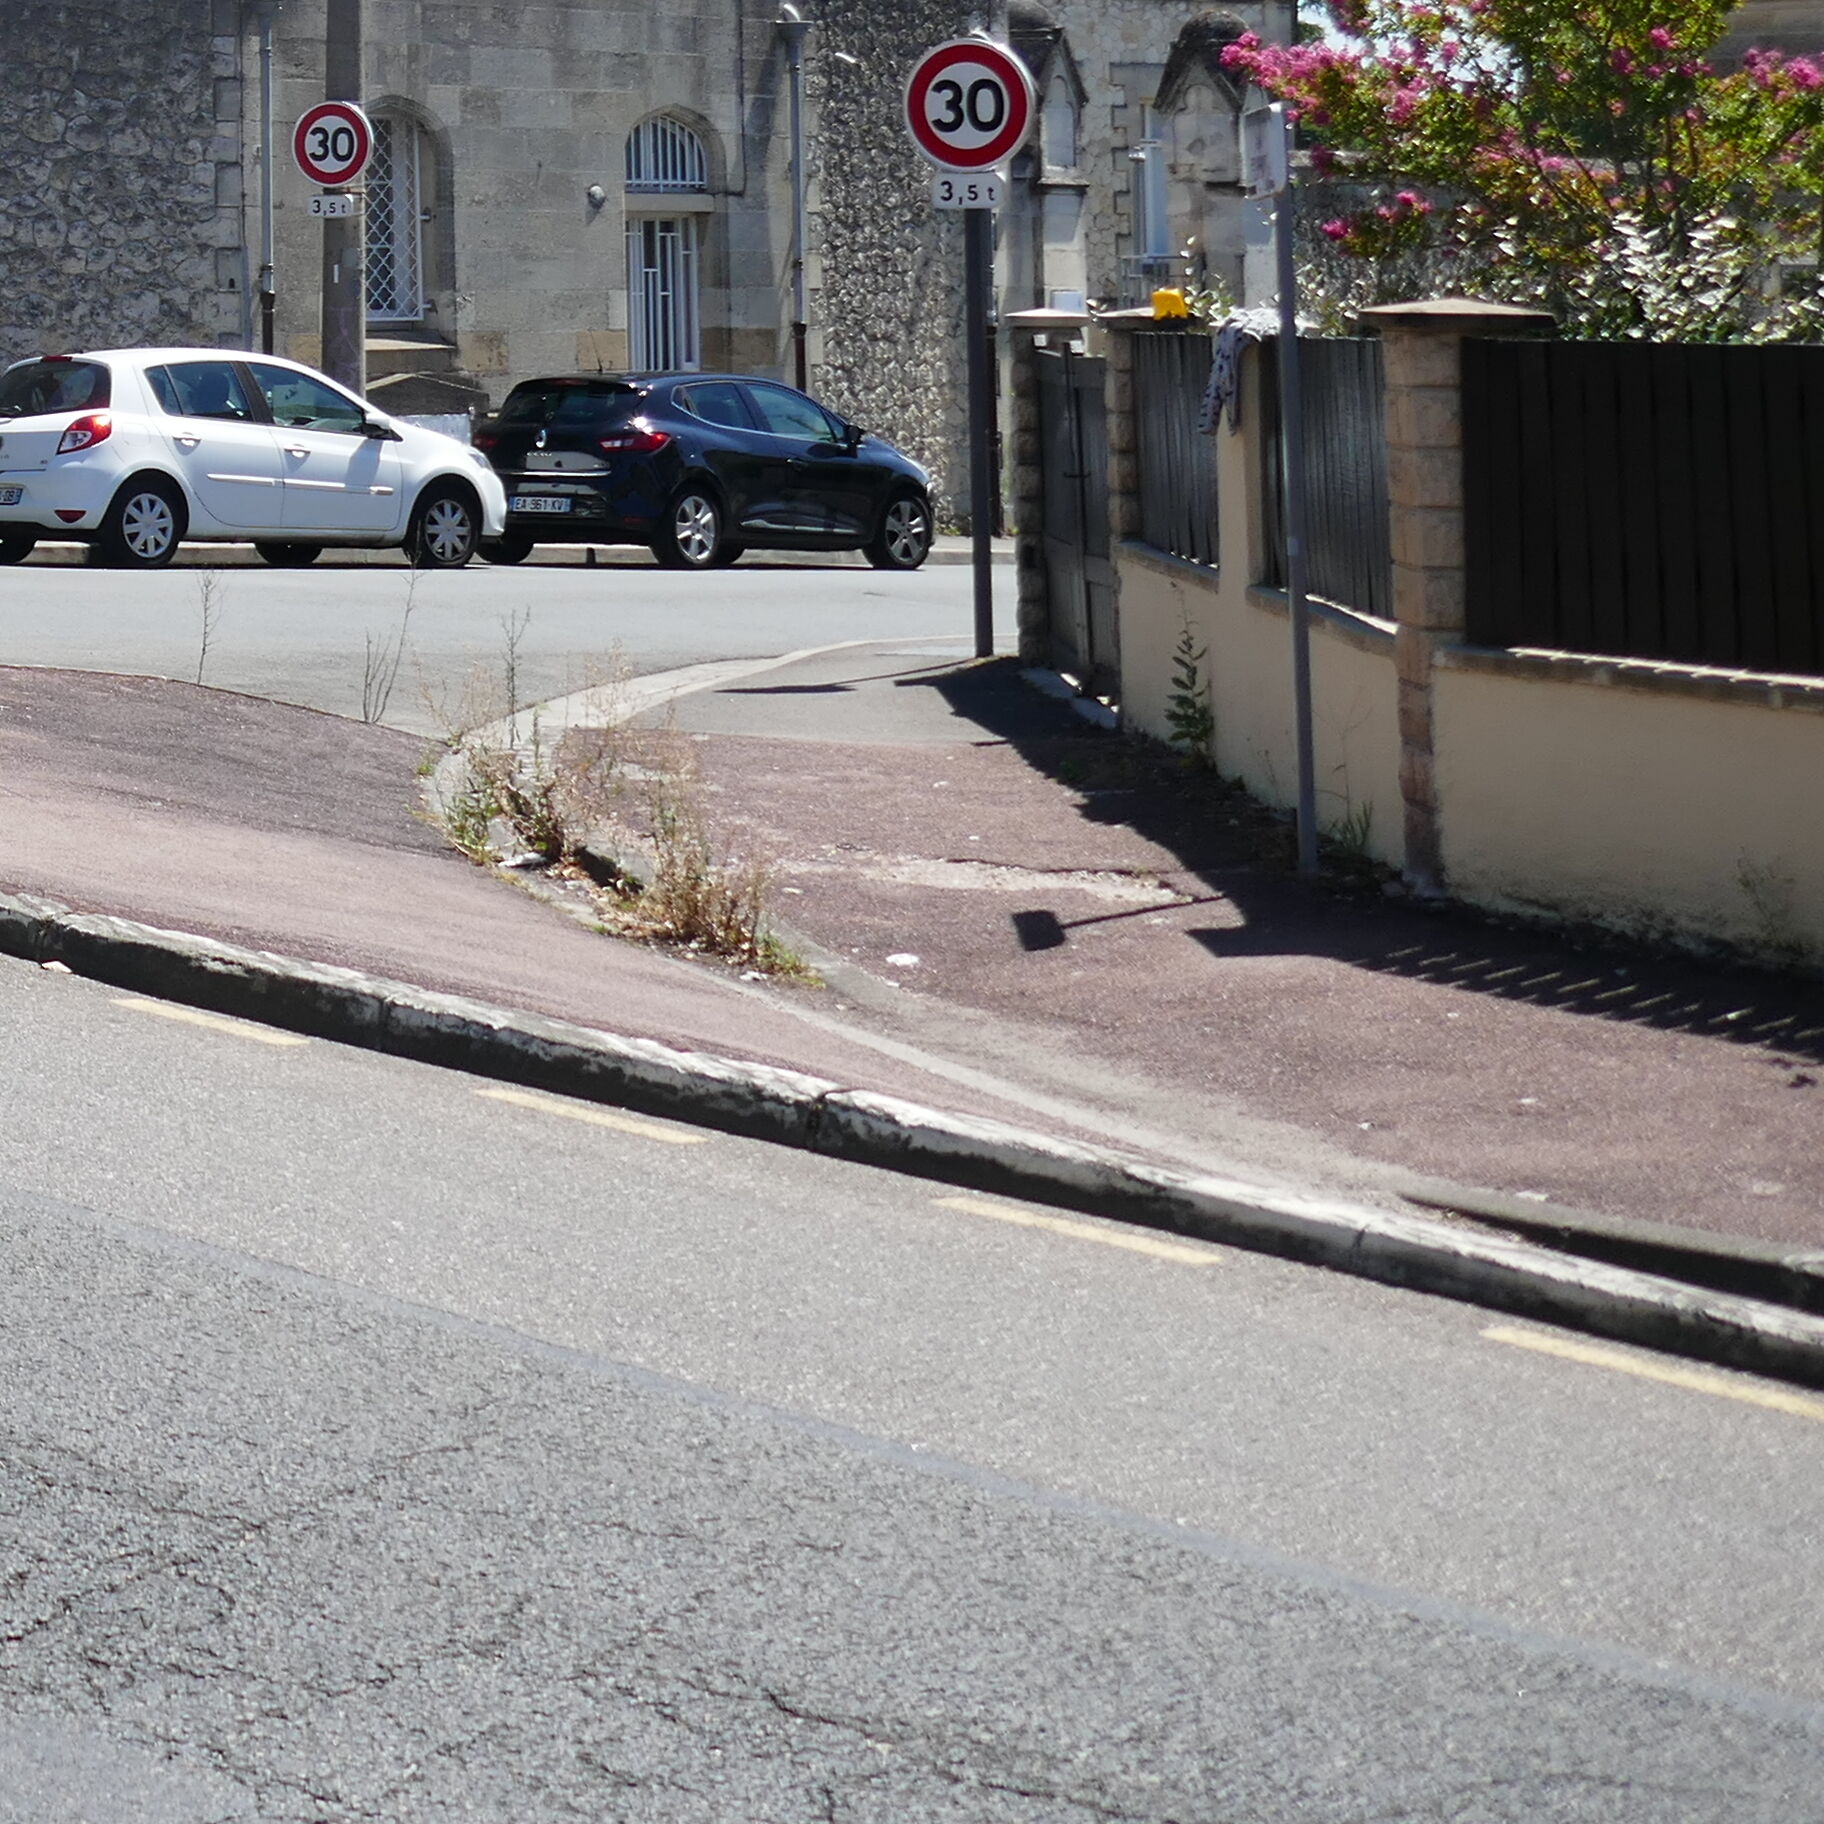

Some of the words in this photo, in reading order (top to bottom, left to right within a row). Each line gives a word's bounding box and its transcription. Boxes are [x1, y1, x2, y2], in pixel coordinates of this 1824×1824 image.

[931, 78, 1005, 133] 30
[309, 126, 355, 163] 30
[312, 199, 336, 216] 3,5
[341, 204, 347, 214] t
[940, 180, 979, 206] 3,5
[987, 187, 995, 201] t
